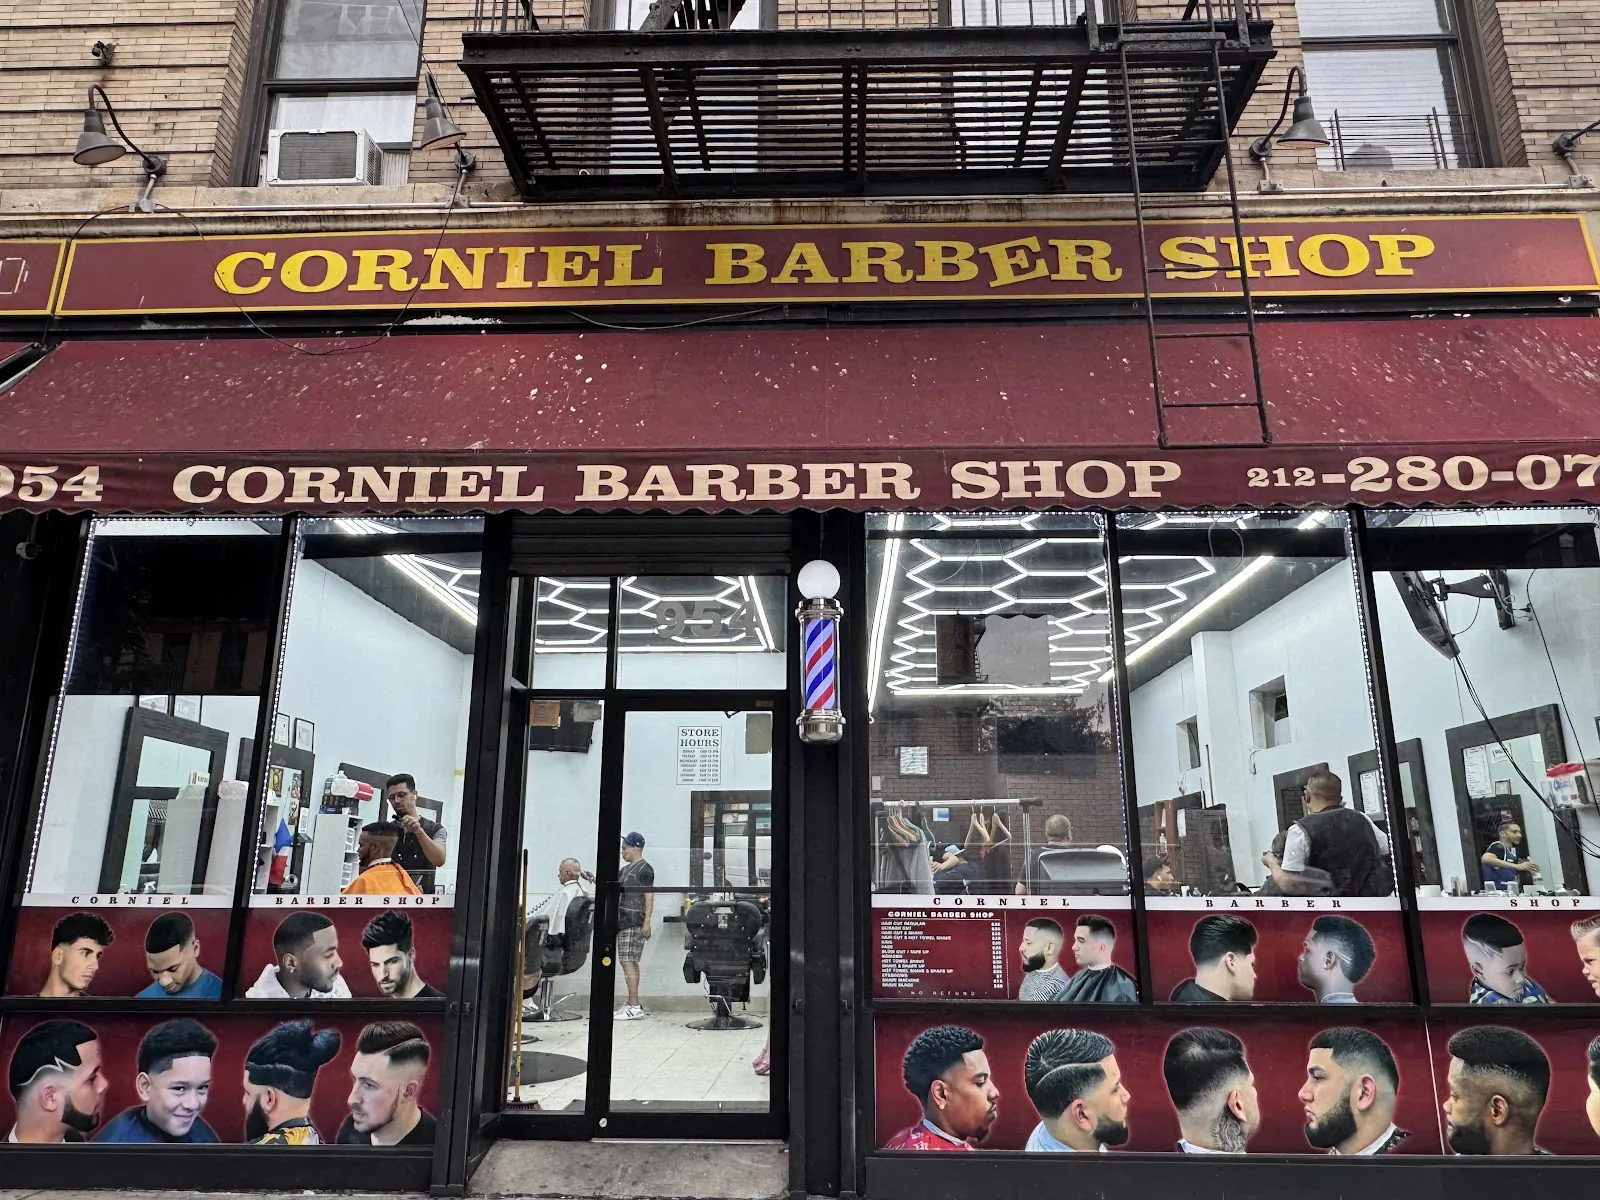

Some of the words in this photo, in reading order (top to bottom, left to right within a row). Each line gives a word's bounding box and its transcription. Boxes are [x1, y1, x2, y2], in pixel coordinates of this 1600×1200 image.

[214, 245, 662, 295] CORNIEL
[705, 237, 1123, 288] BARBER
[1161, 233, 1436, 279] SHOP
[173, 465, 543, 503] CORNIEL
[575, 463, 920, 502] BARBER
[951, 460, 1182, 499] SHOP
[655, 600, 755, 638] 954
[681, 729, 719, 737] STORE
[680, 739, 719, 747] HOURS
[71, 896, 189, 905] CORNIEL
[275, 896, 364, 905] BARBER
[383, 896, 440, 905] SHOP
[933, 897, 1069, 906] CORNIEL
[1205, 899, 1341, 908] BARBER
[1510, 899, 1580, 907] SHOP
